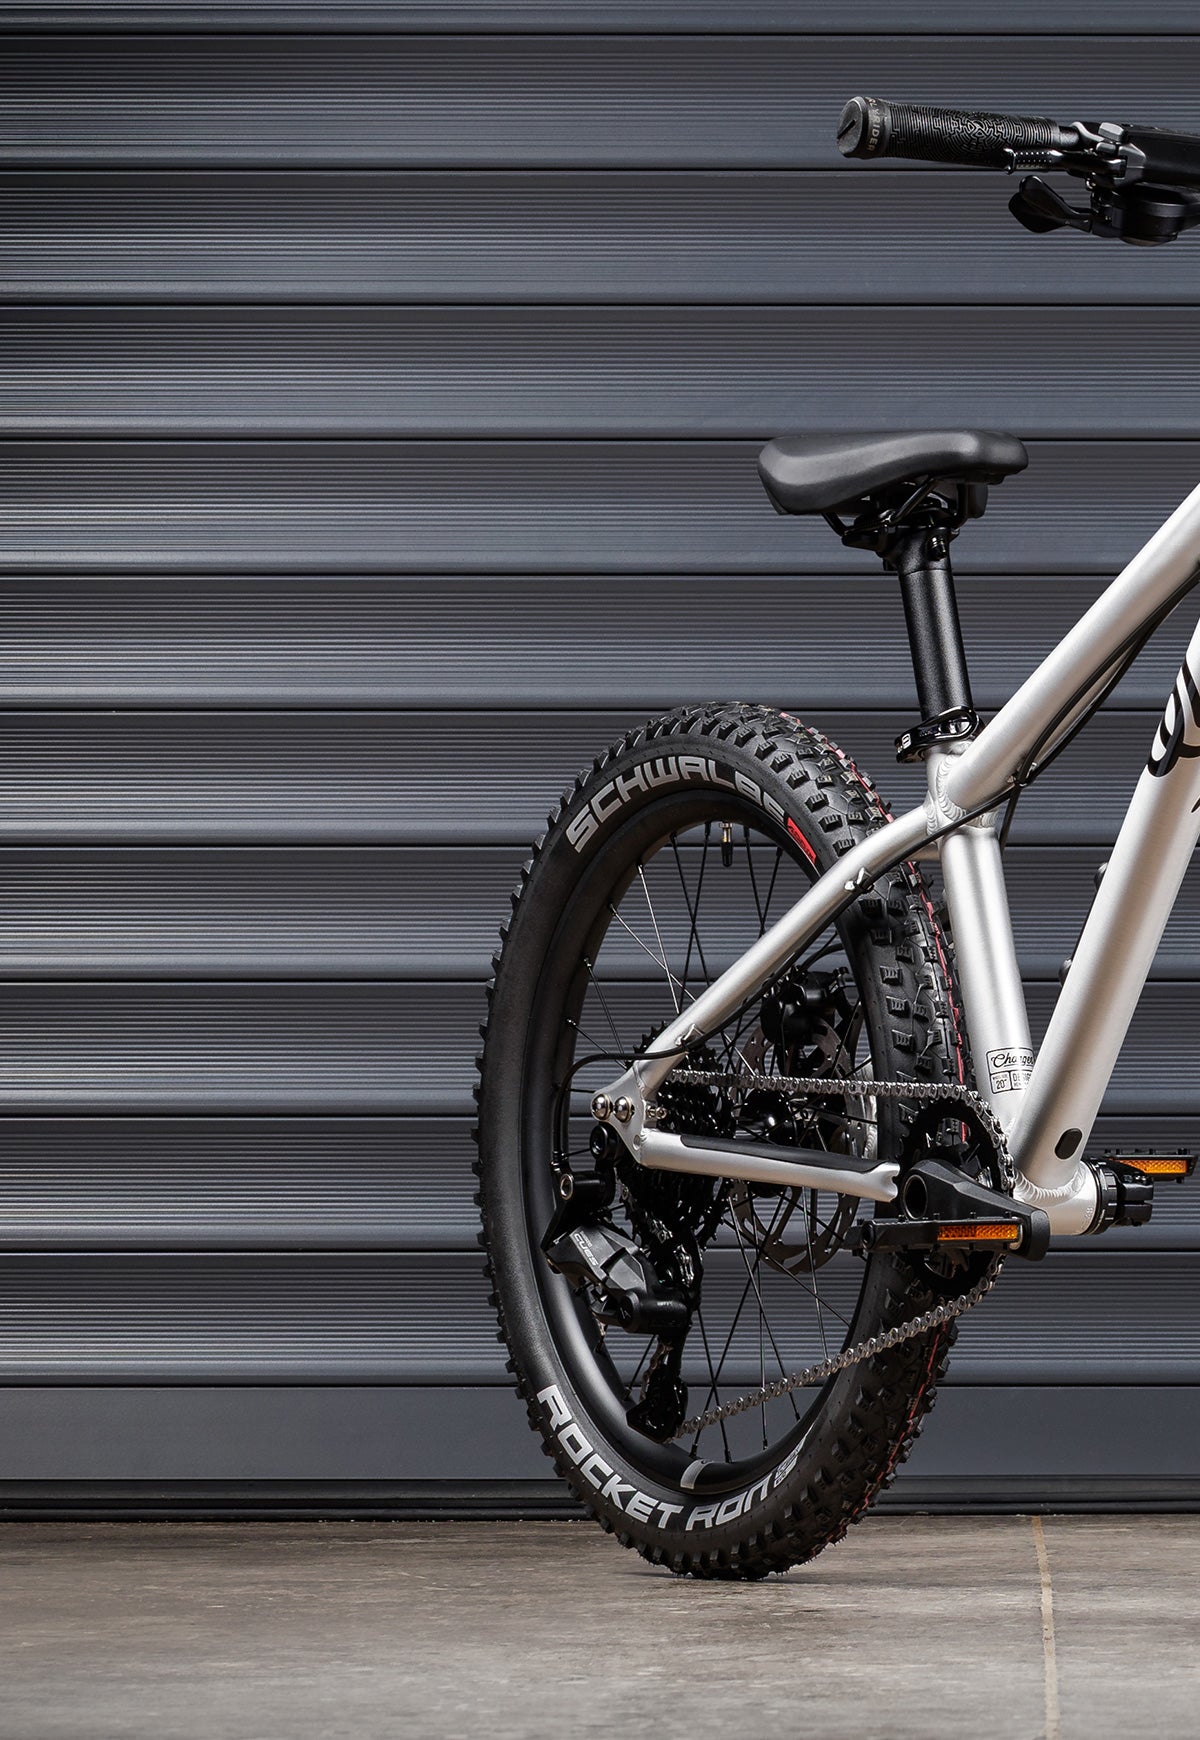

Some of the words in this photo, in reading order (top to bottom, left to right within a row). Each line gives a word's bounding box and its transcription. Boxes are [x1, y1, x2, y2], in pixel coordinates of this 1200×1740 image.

[565, 755, 785, 853] SCHWALBE
[537, 1384, 684, 1529] ROCKET
[685, 1472, 773, 1531] RON
